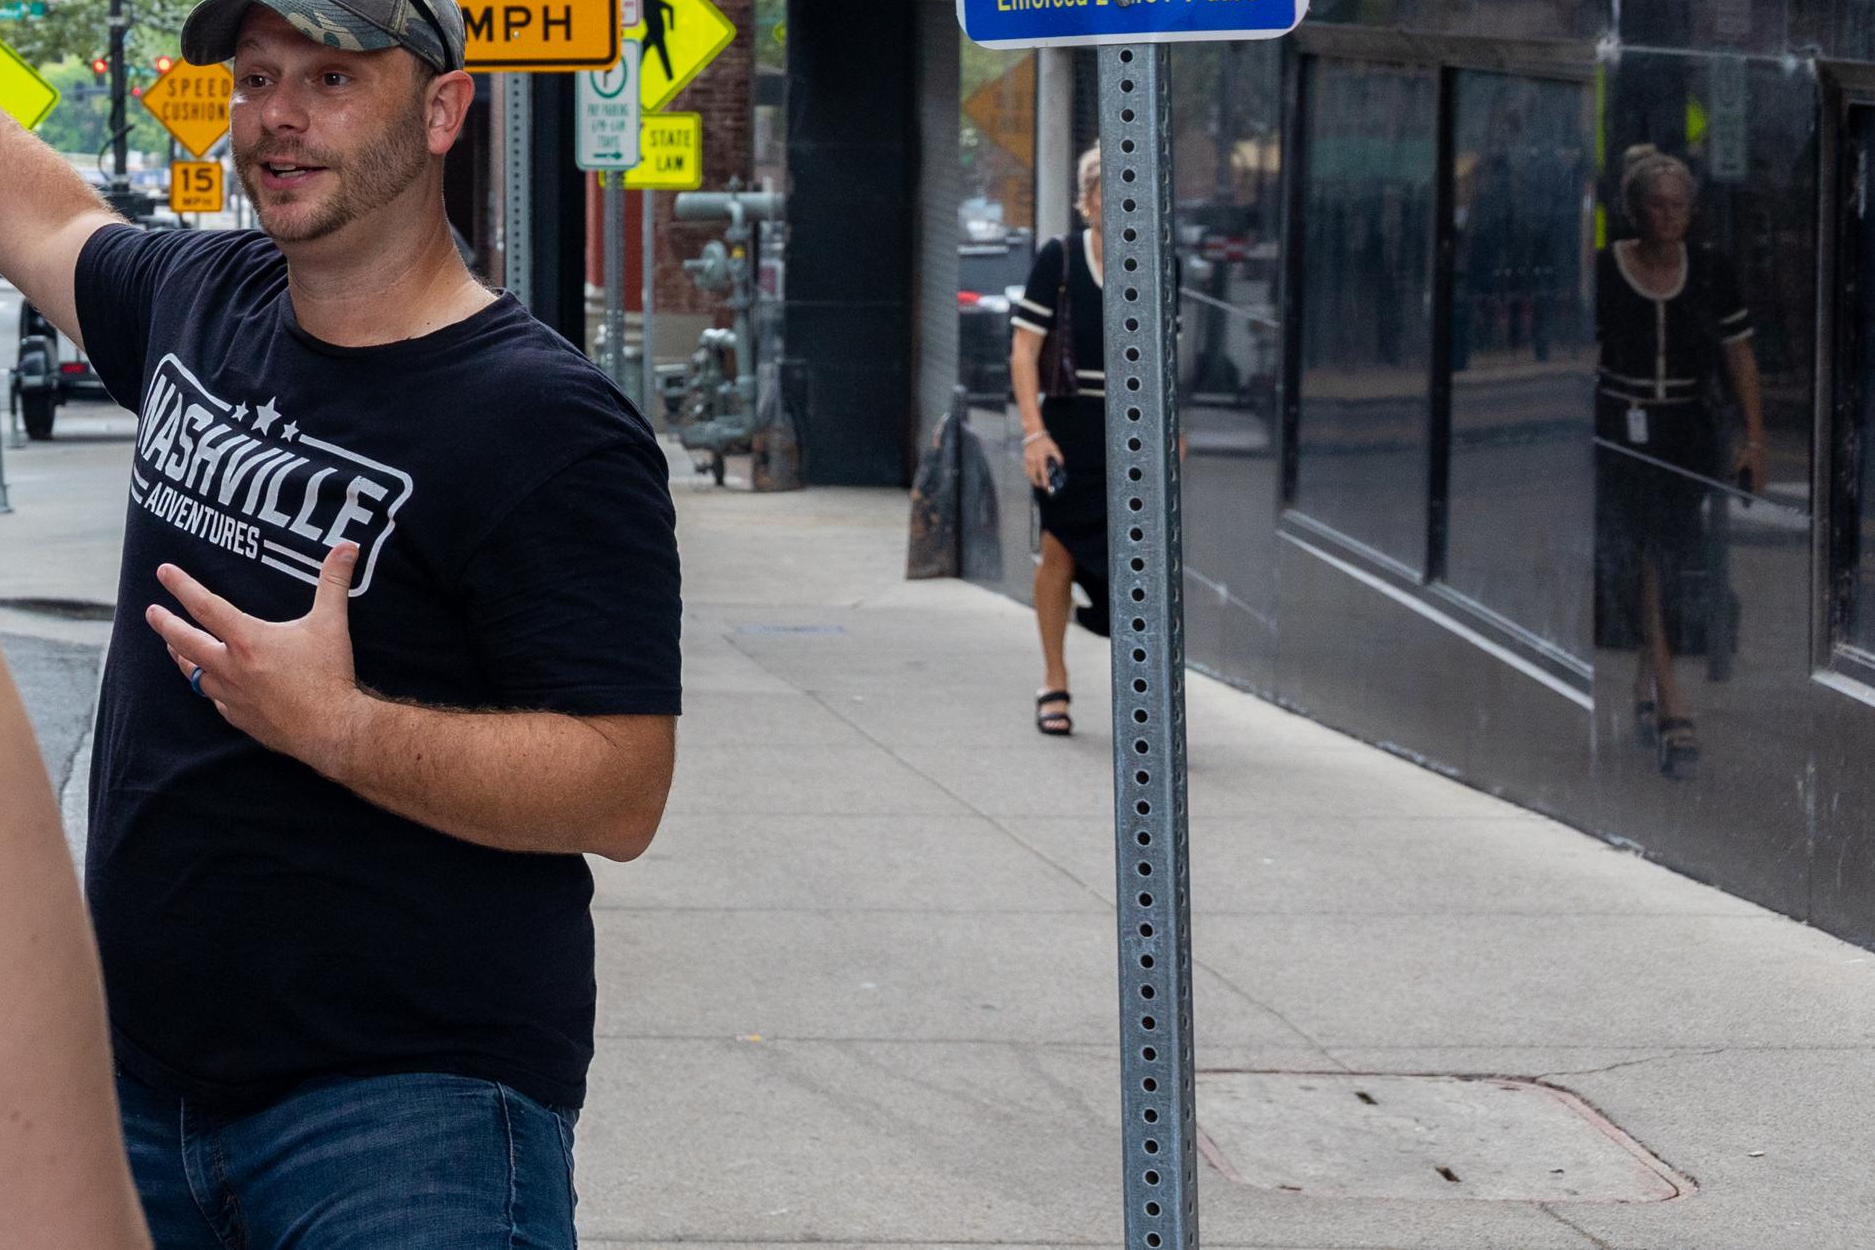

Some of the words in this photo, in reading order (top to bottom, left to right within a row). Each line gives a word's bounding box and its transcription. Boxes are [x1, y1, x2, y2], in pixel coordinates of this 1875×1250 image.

[465, 5, 572, 42] MPH
[166, 77, 232, 98] SPEED
[161, 101, 226, 121] CUSHION
[650, 129, 692, 148] STATE
[655, 154, 685, 171] LAW
[181, 167, 215, 193] 15
[138, 373, 388, 550] NASHVILLE
[143, 480, 261, 560] ADVENTURES
